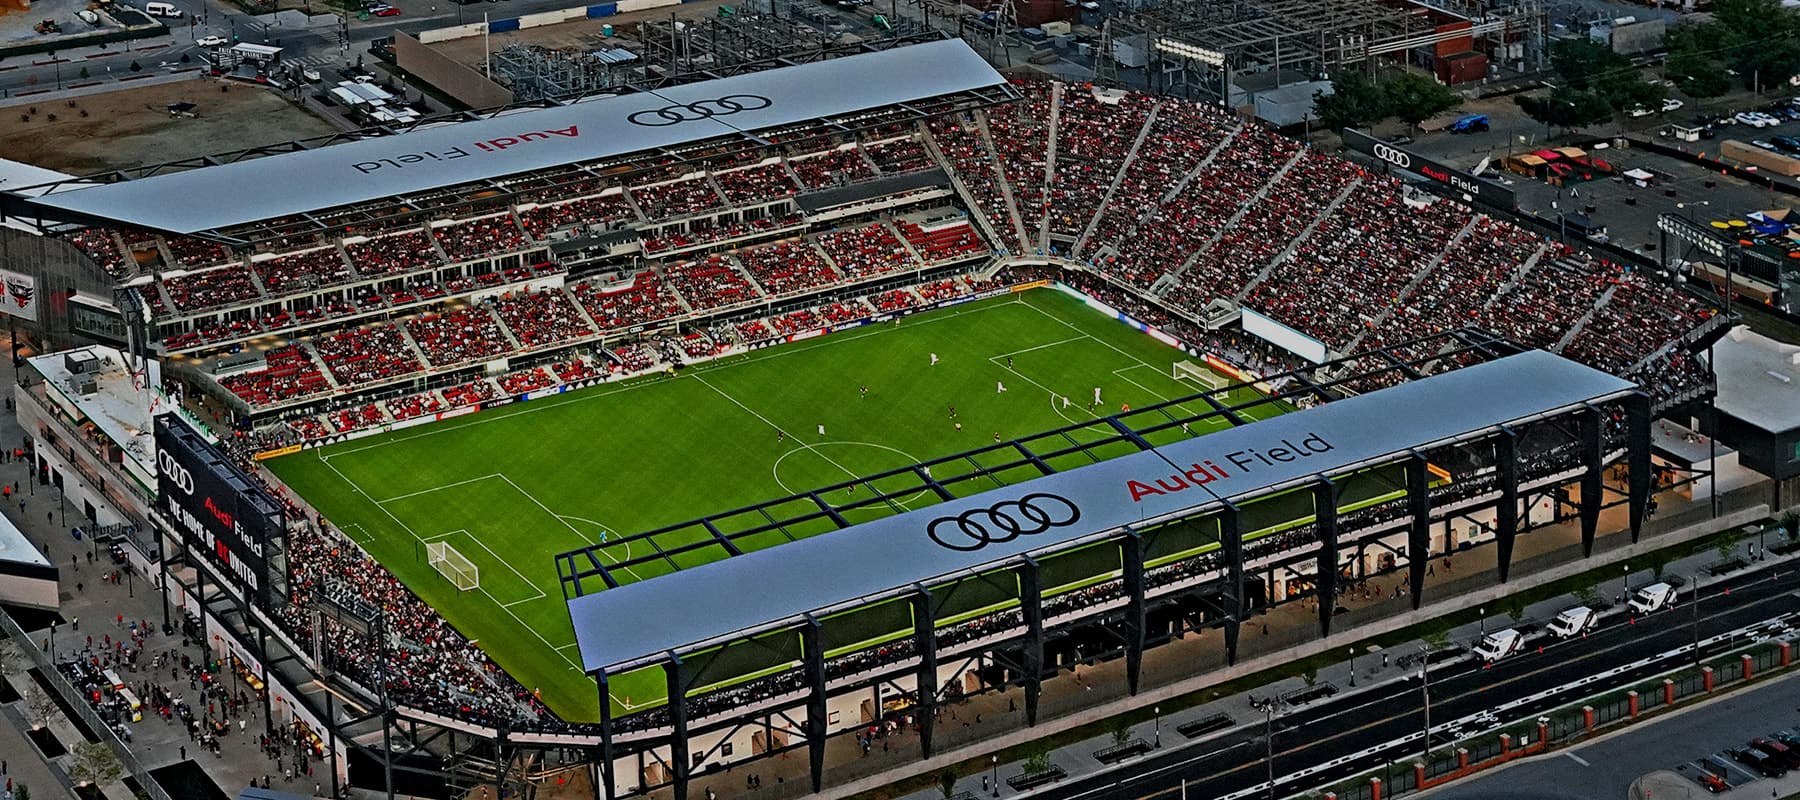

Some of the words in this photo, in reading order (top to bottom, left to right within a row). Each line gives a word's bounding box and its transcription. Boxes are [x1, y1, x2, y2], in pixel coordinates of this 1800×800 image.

[351, 147, 471, 174] Field
[474, 125, 579, 152] Audi
[1421, 166, 1449, 182] Audi
[1451, 175, 1479, 194] Field
[1127, 460, 1230, 502] Audi
[1225, 433, 1335, 473] Field
[204, 497, 233, 529] Audi
[234, 520, 262, 558] Field
[183, 509, 205, 542] HOME
[206, 529, 216, 551] OF
[229, 550, 258, 591] UNITED
